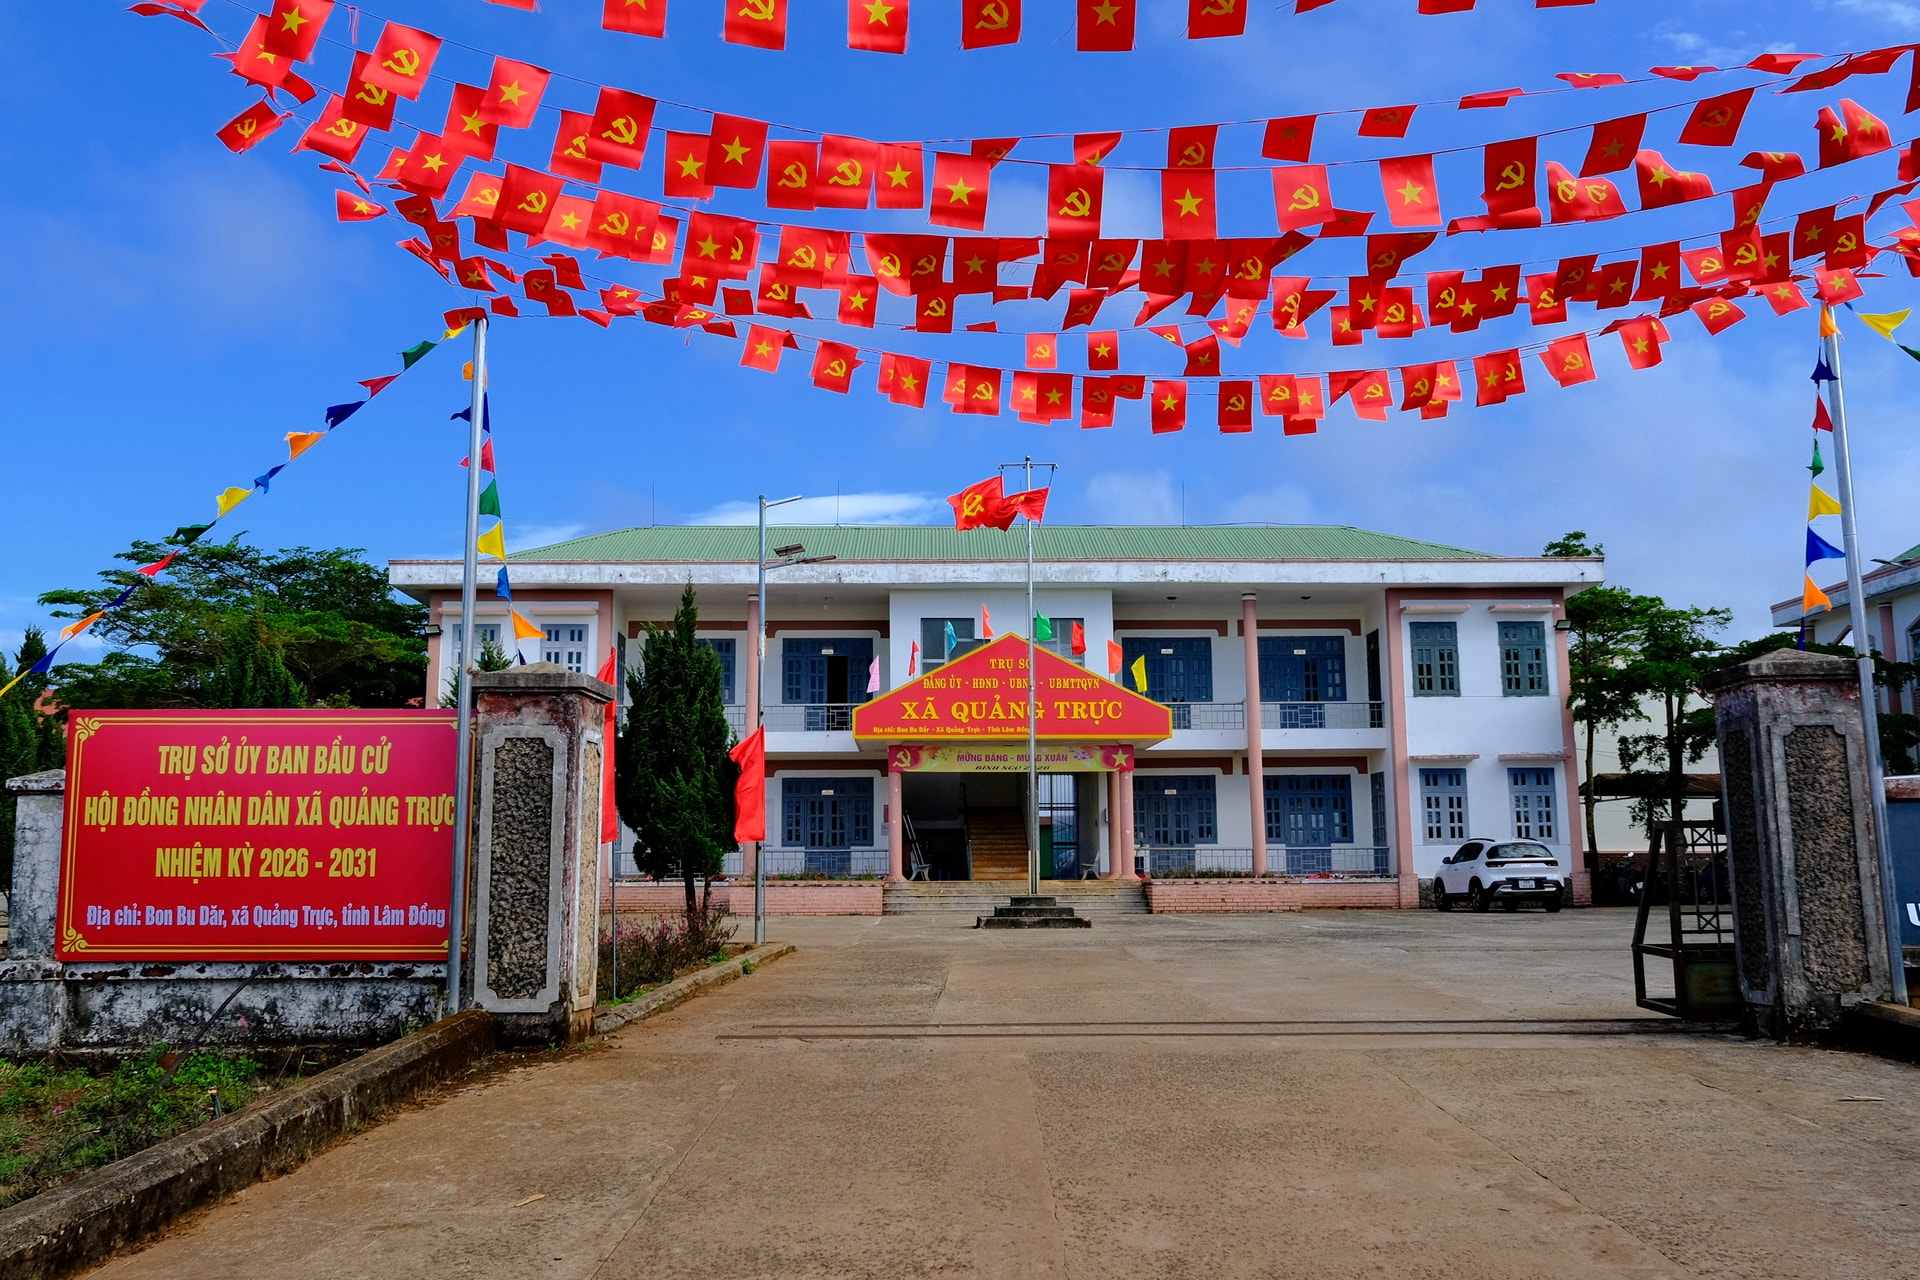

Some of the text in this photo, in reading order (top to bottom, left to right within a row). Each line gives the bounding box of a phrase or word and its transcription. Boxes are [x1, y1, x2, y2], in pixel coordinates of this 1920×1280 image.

[989, 659, 1014, 672] TRỤ
[923, 675, 946, 689] ĐẢNG
[949, 674, 962, 689] ỦY
[972, 678, 999, 689] HĐND
[1009, 678, 1030, 689] UBN
[1049, 678, 1100, 691] UBMTTQVN
[901, 694, 1123, 726] XÃ QUẢNG TRỰC
[159, 736, 392, 780] TRỤ SỞ ỦY BAN BẦU CỬ
[84, 786, 455, 832] HỘI ĐỒNG NHÂN DÂN XÃ QUẢNG TRỰC
[155, 842, 222, 884] NHIỆM
[227, 842, 254, 877] KỲ
[259, 848, 309, 878] 2026
[328, 848, 377, 878] 2031
[86, 902, 446, 930] Địa chỉ: Bon Bu Dăr, xã Quảng Trực, tỉnh Lâm Đồng
